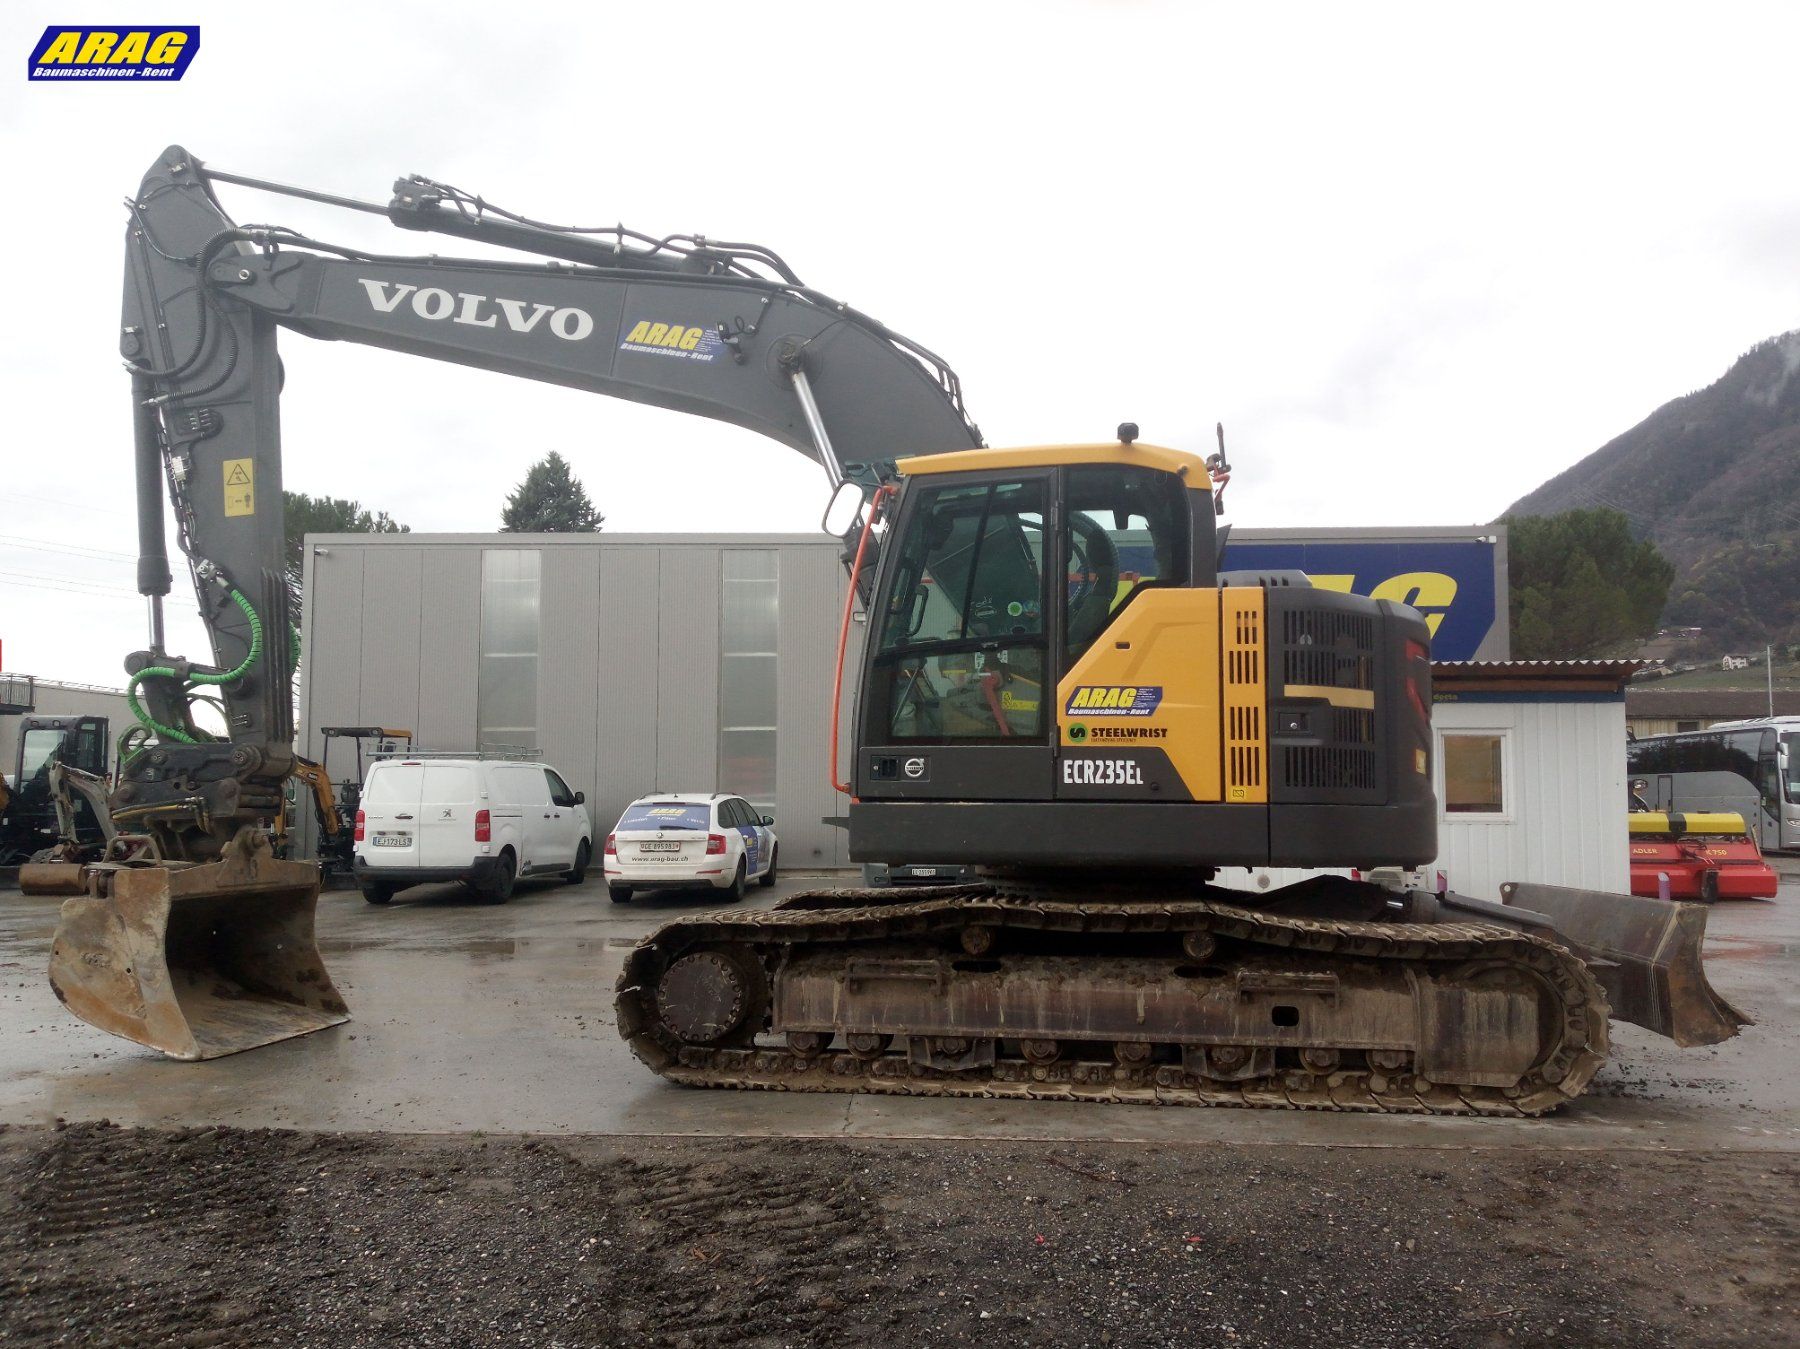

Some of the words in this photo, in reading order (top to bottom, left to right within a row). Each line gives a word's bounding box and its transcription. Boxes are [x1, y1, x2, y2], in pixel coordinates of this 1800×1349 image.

[358, 278, 594, 341] VOLVO
[625, 320, 703, 350] ARAG
[1071, 687, 1138, 708] ARAG
[1091, 728, 1168, 738] STEELWRIST
[1063, 760, 1144, 785] ECR235EL
